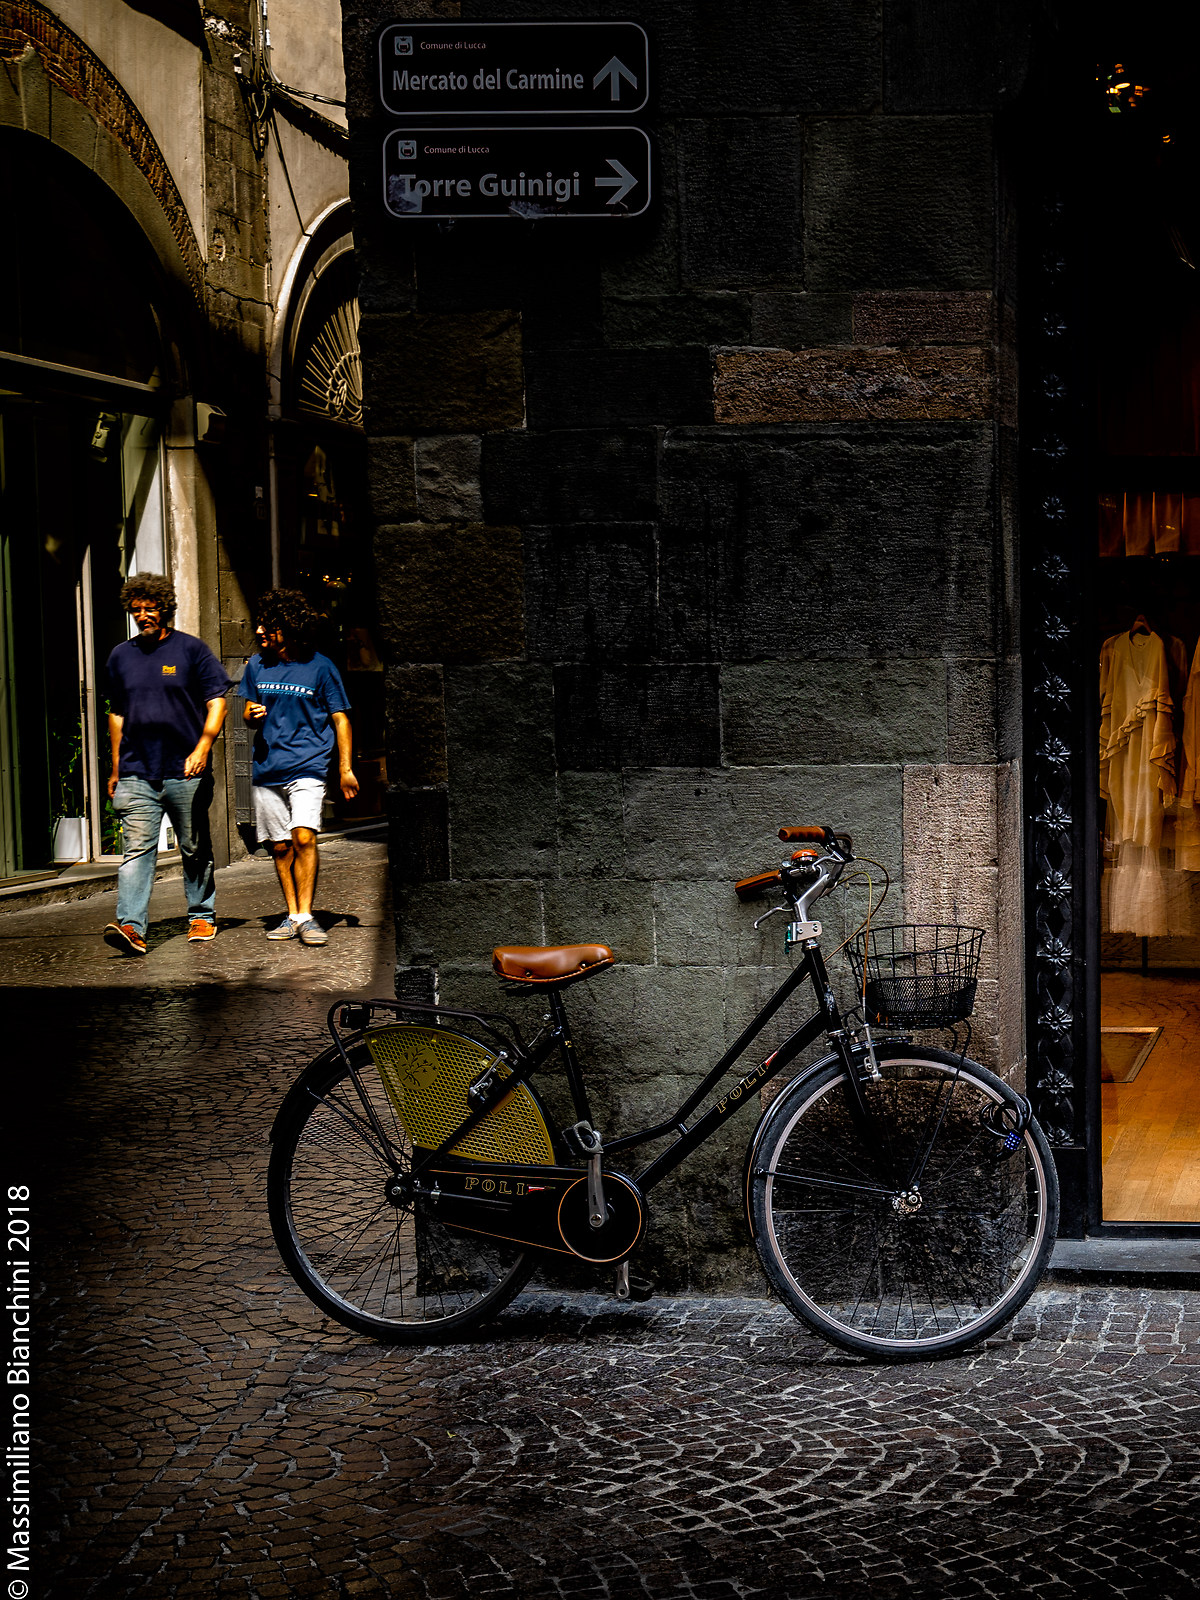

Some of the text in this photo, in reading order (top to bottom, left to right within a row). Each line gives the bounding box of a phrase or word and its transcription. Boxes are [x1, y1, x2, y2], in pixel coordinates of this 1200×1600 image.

[420, 41, 487, 50] Comune di Lucca
[393, 68, 584, 91] Mercato del Carmine
[424, 145, 490, 154] Comune di Lucca
[399, 171, 580, 203] Torre Guinigi
[256, 683, 306, 694] QUIKSILVER
[715, 1064, 766, 1114] POLI
[464, 1176, 525, 1196] POLI
